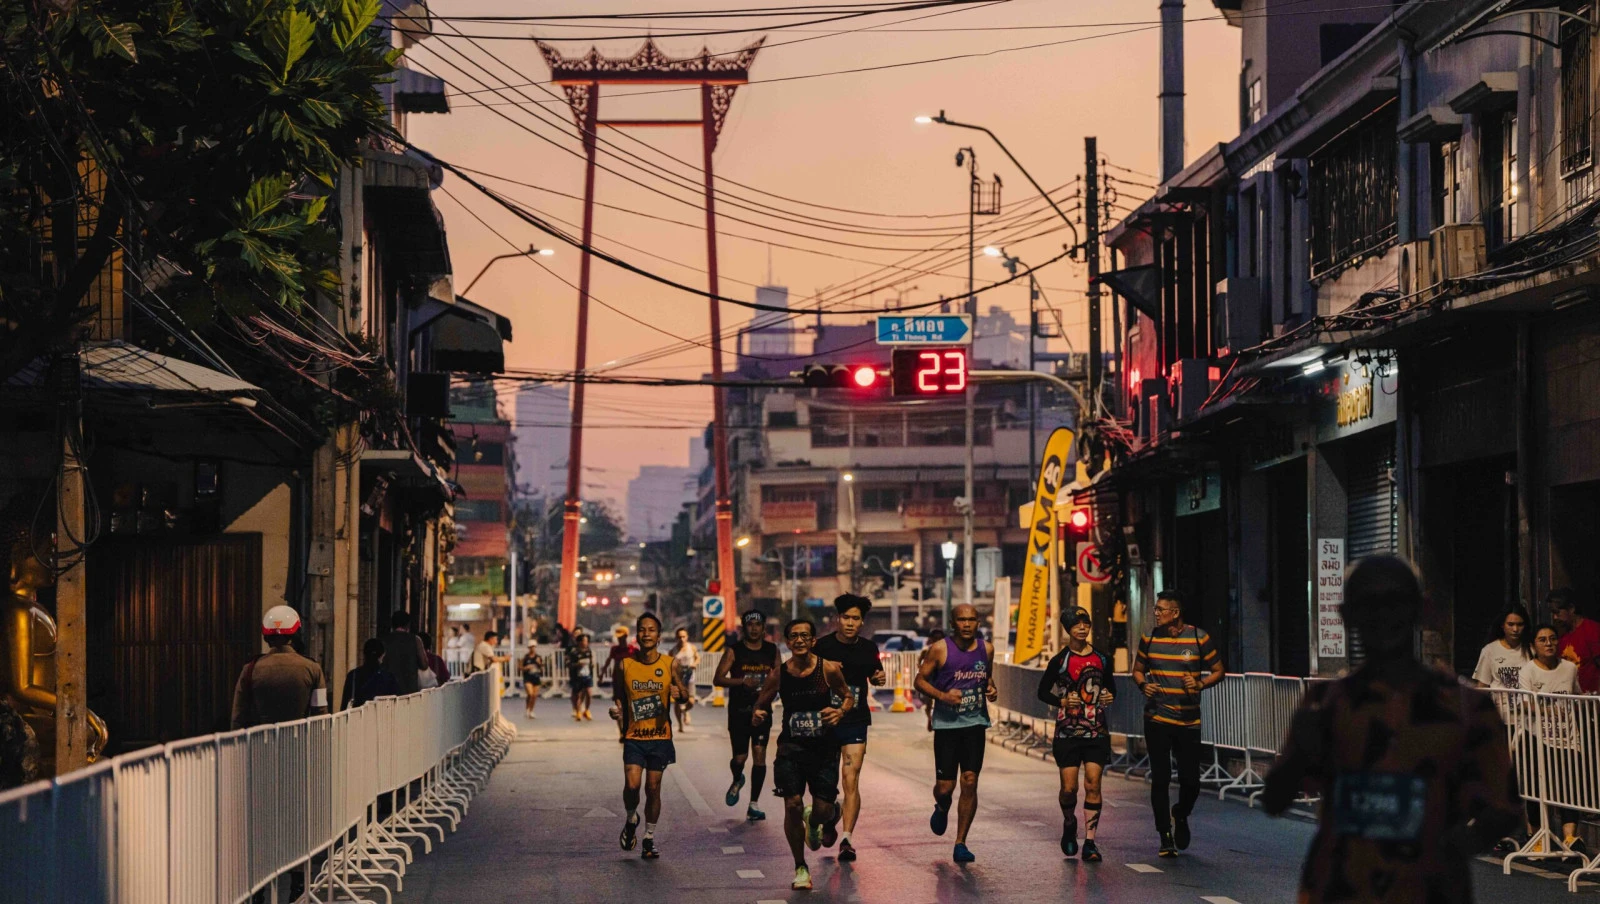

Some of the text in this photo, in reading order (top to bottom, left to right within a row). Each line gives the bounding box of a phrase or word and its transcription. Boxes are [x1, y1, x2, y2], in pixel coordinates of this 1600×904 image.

[919, 352, 965, 391] 23
[1323, 540, 1339, 554] ร้าน
[1026, 568, 1043, 649] MARATHON
[637, 702, 655, 711] 2479
[795, 720, 814, 728] 1565
